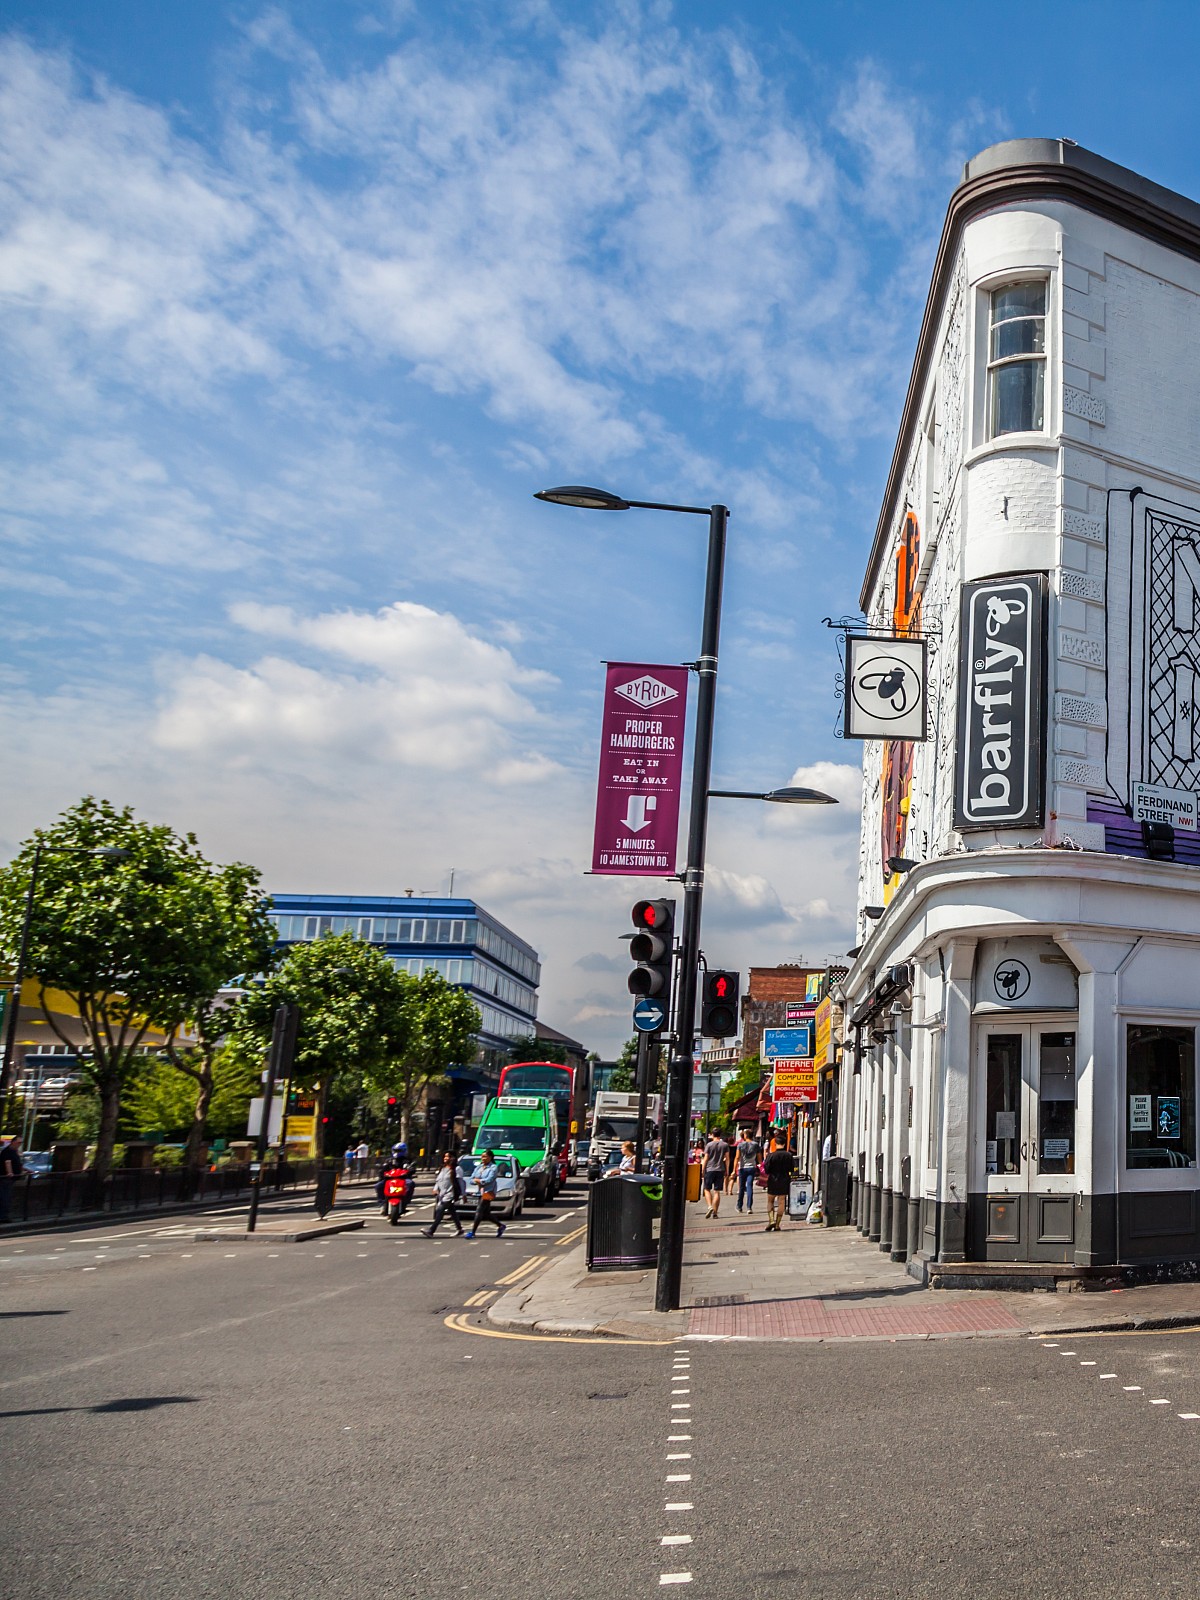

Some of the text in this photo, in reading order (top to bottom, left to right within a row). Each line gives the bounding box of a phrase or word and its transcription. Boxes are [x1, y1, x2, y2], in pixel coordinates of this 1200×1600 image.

[627, 681, 667, 700] BYRON
[625, 719, 663, 734] PROPER
[970, 637, 1024, 812] barfly
[610, 733, 675, 750] HAMBURGERS
[623, 758, 660, 767] EAT IN
[612, 775, 668, 785] TAKE AWAY
[1137, 794, 1193, 814] FERDINAND
[1137, 808, 1194, 827] STREET NW1
[616, 838, 655, 850] 5 MINUTES
[600, 854, 669, 867] 10 JAMESTOWN RD.
[777, 1060, 815, 1068] INTERNET
